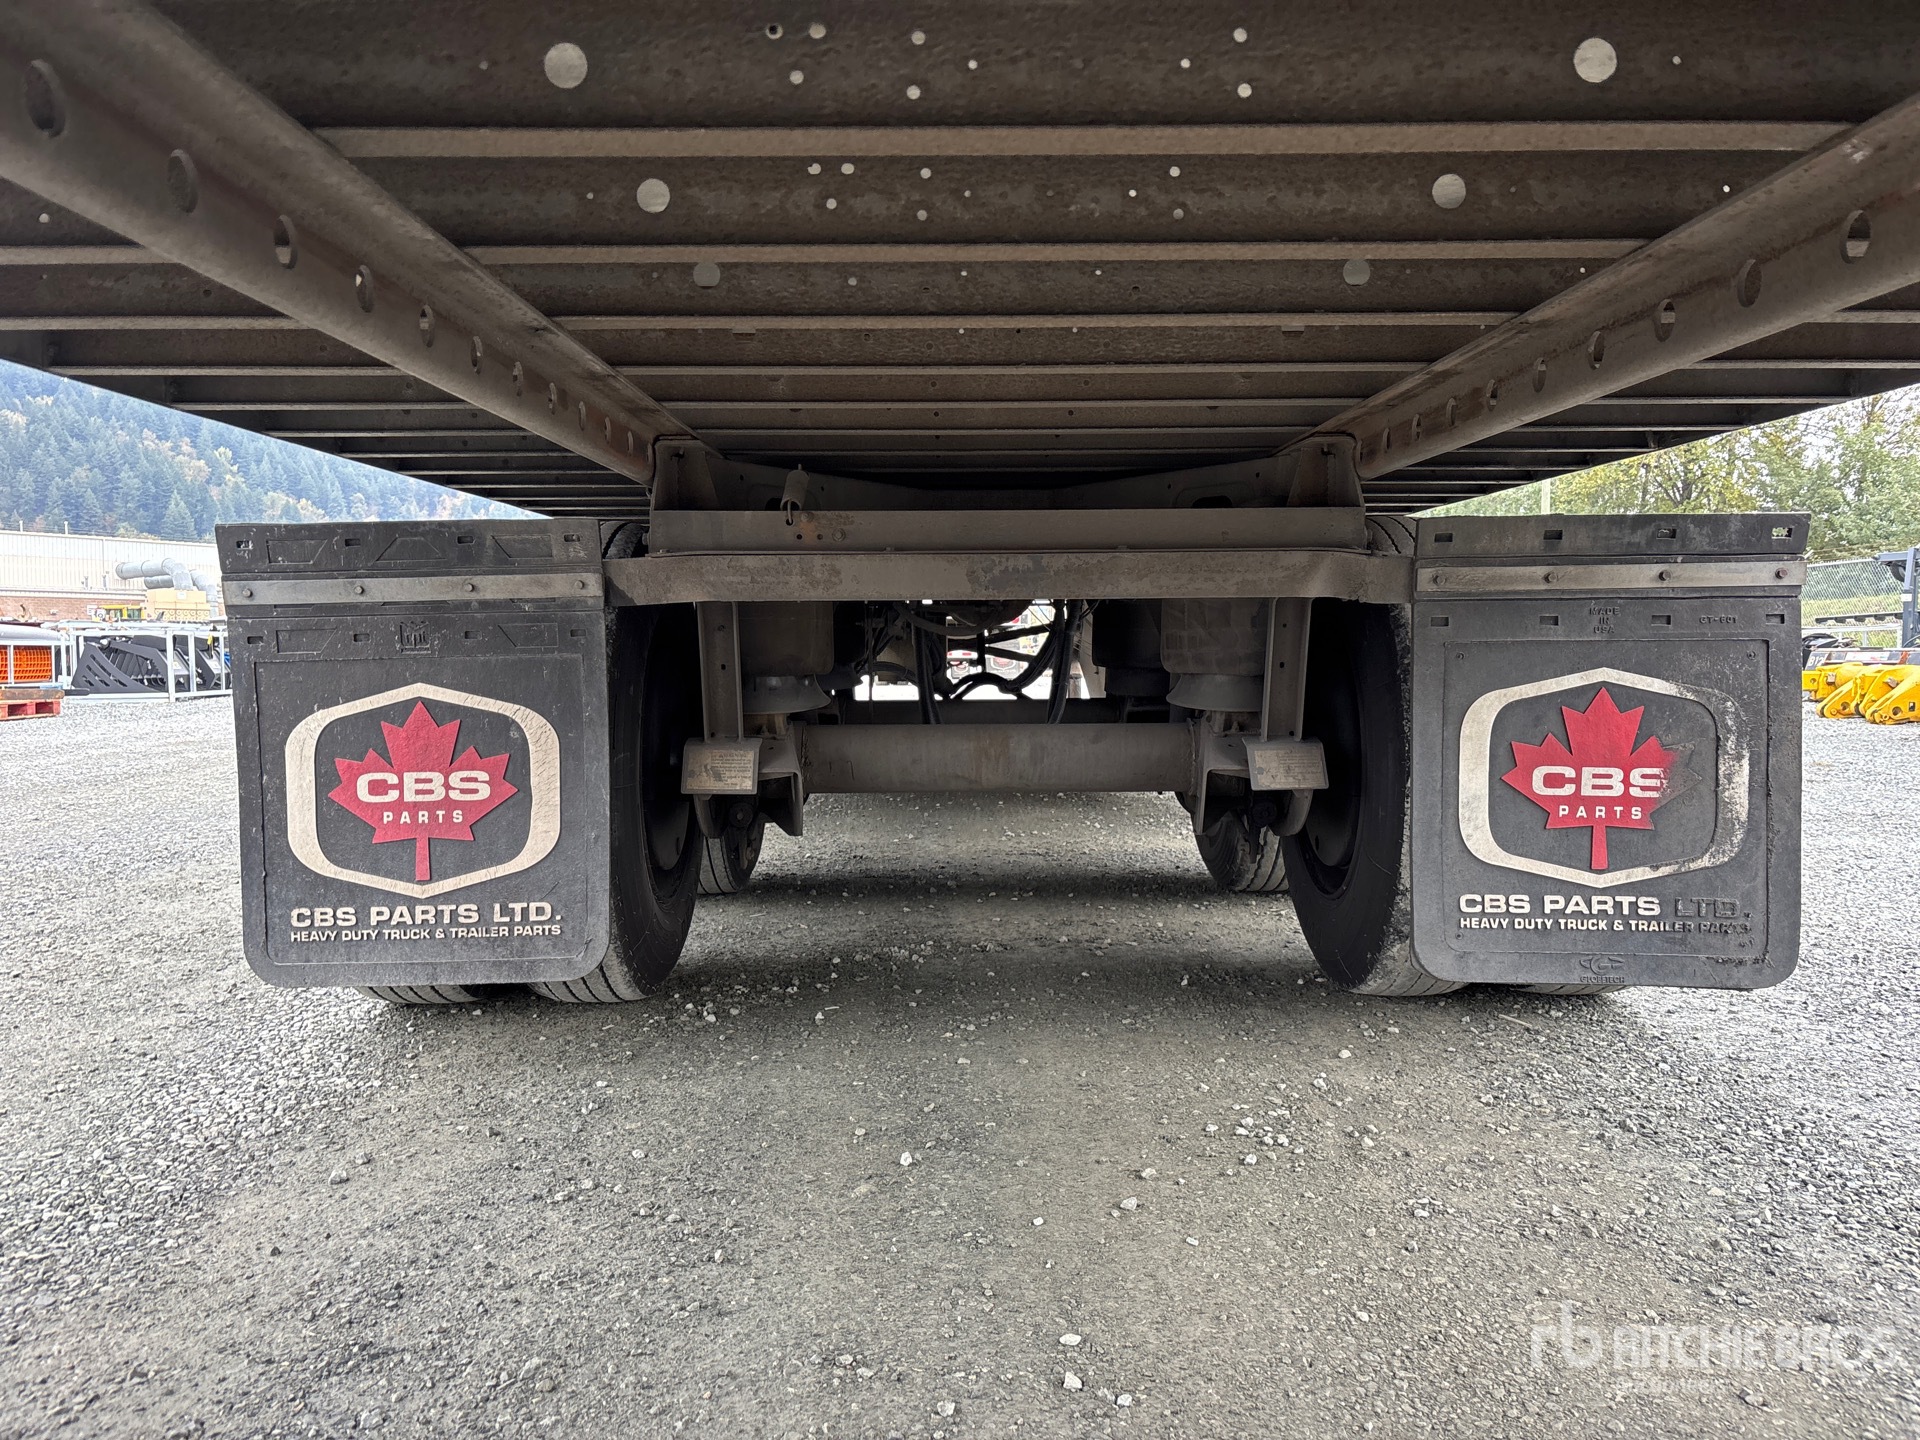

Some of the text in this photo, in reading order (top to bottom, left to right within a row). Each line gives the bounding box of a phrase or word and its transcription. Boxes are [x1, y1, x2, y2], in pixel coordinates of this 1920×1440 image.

[1590, 606, 1621, 616] MADE
[1599, 616, 1611, 626] IN
[1593, 625, 1616, 635] USA
[356, 770, 491, 803] CBS
[1531, 765, 1669, 798] CBS
[383, 810, 464, 825] PARTS
[1558, 804, 1643, 820] PARTS
[1459, 893, 1752, 919] CBS PARTS LTD.
[290, 901, 563, 928] CBS PARTS LTD.
[1460, 917, 1509, 930] HEAVY
[1514, 918, 1554, 930] DUTY
[1558, 918, 1608, 931] TRUCK
[1613, 919, 1625, 931] &
[1628, 919, 1695, 933] TRAILER
[290, 924, 562, 943] HEAVY DUTY TRUCK & TRAILER PARTS
